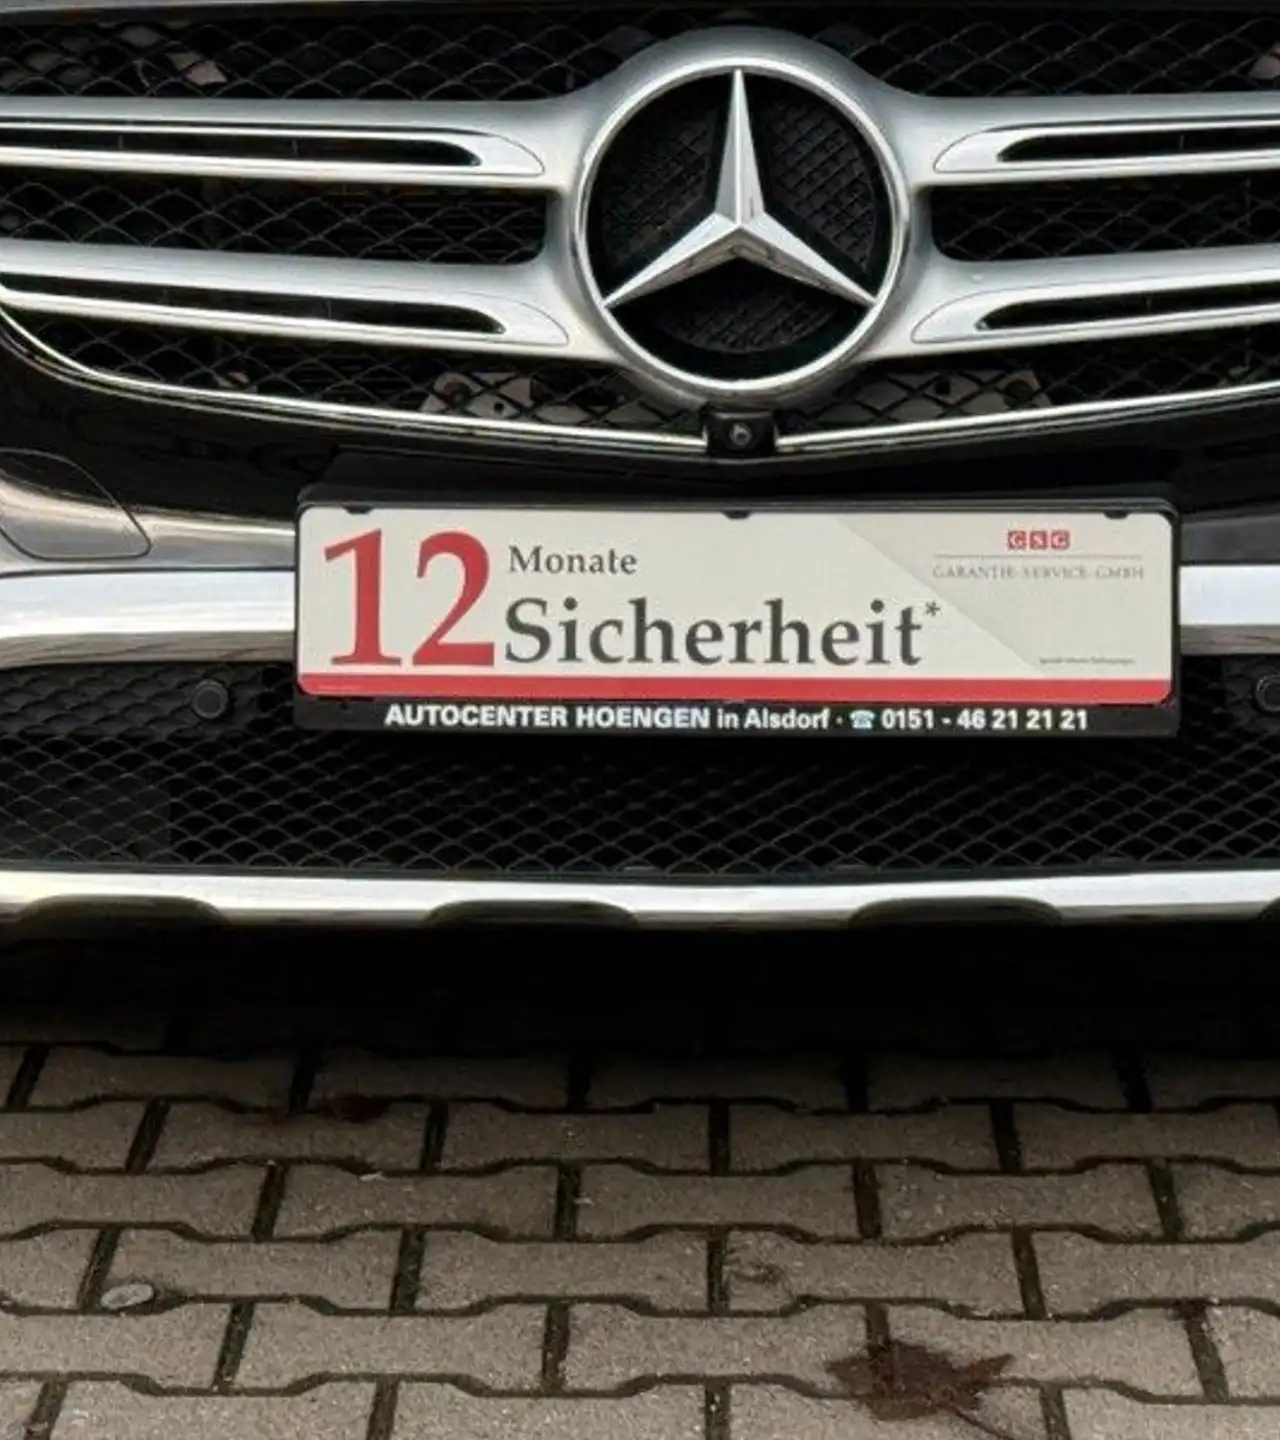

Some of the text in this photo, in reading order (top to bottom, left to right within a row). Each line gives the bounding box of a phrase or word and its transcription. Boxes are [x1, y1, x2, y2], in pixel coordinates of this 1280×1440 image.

[508, 545, 639, 575] Monate
[323, 527, 494, 667] 12
[384, 703, 568, 728] AUTOCENTER
[576, 705, 710, 729] HOENGEN
[717, 707, 740, 729] in
[744, 708, 832, 729] Alsdorf
[881, 708, 935, 730] 0151
[956, 708, 986, 730] 46
[991, 708, 1018, 730] 21
[1025, 709, 1053, 731] 21
[1059, 709, 1089, 731] 21
